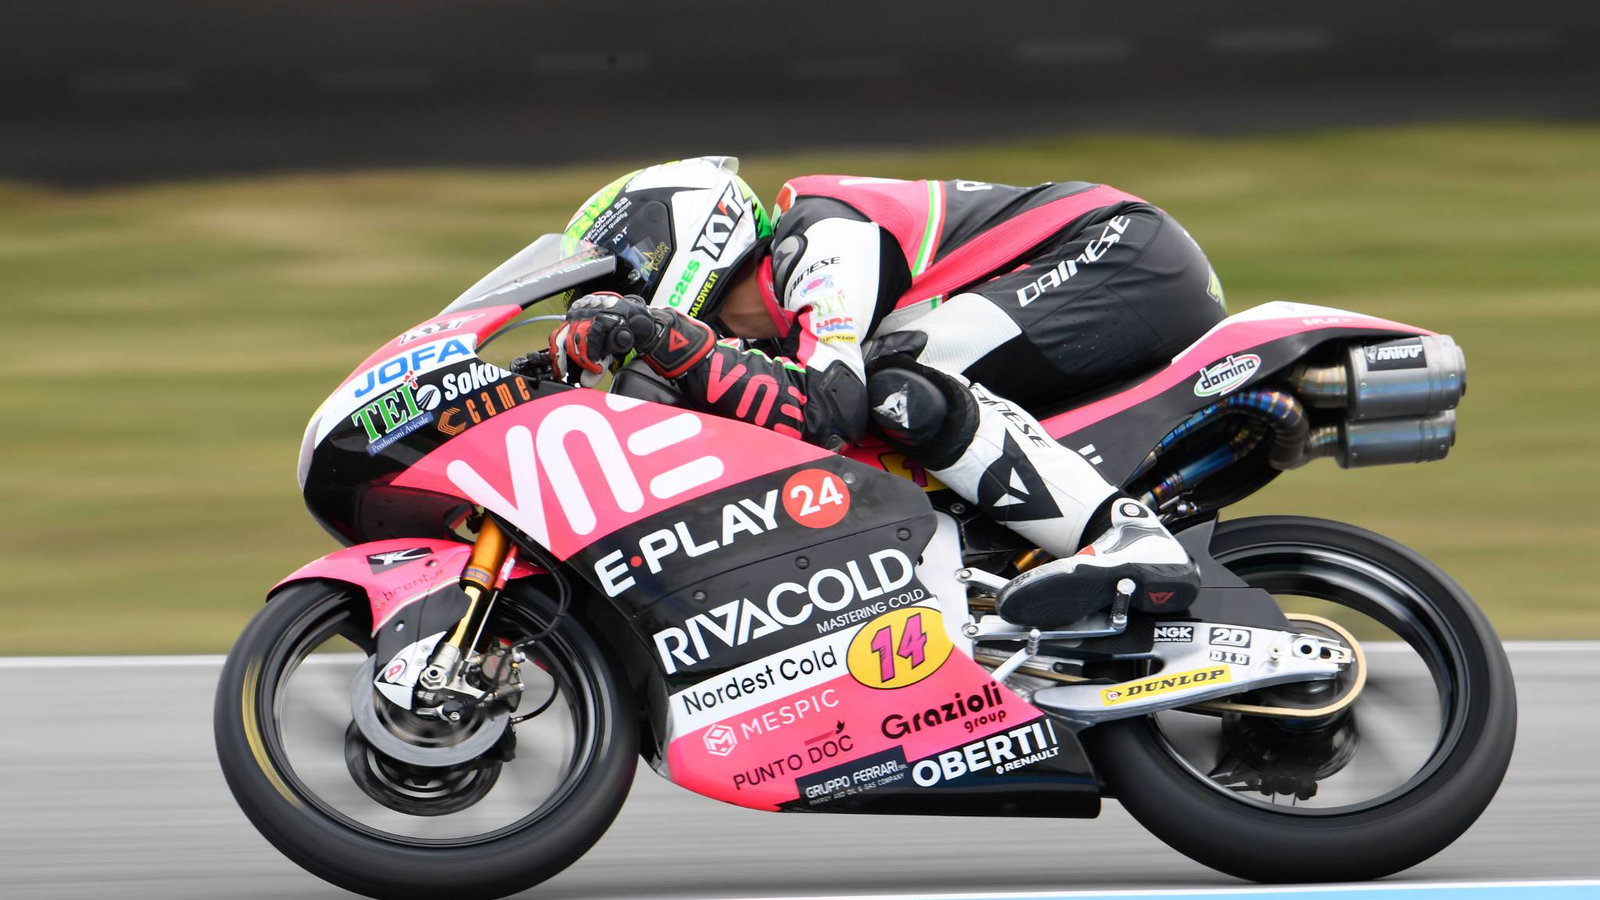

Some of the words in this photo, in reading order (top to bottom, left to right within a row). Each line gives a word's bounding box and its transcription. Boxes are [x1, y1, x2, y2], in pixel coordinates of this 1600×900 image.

[690, 179, 752, 263] KYT
[668, 259, 701, 307] C2ES
[1016, 215, 1131, 308] DAINESE
[816, 317, 854, 334] HRC
[354, 339, 472, 398] JOFA
[1200, 356, 1256, 390] domino
[351, 383, 424, 443] TEI
[970, 384, 1051, 448] AINESE
[790, 476, 844, 518] 24
[652, 548, 913, 675] RIVACOLD
[816, 602, 887, 634] MASTERING
[888, 588, 925, 609] COLD
[1153, 626, 1193, 638] NGK
[871, 612, 928, 684] 14
[1210, 628, 1250, 647] 2D
[682, 664, 776, 715] Nordest
[779, 645, 838, 682] Cold
[1126, 669, 1225, 697] DUNLOP
[740, 689, 840, 740] MESPIC
[881, 680, 1003, 739] Grazioli
[964, 709, 1007, 733] group
[733, 753, 803, 791] PUNTO
[807, 735, 854, 764] DOC
[805, 775, 851, 798] GRUPPO
[852, 760, 899, 784] FERRARI
[911, 722, 1048, 787] OBERTI
[1004, 747, 1059, 773] RENAULT
